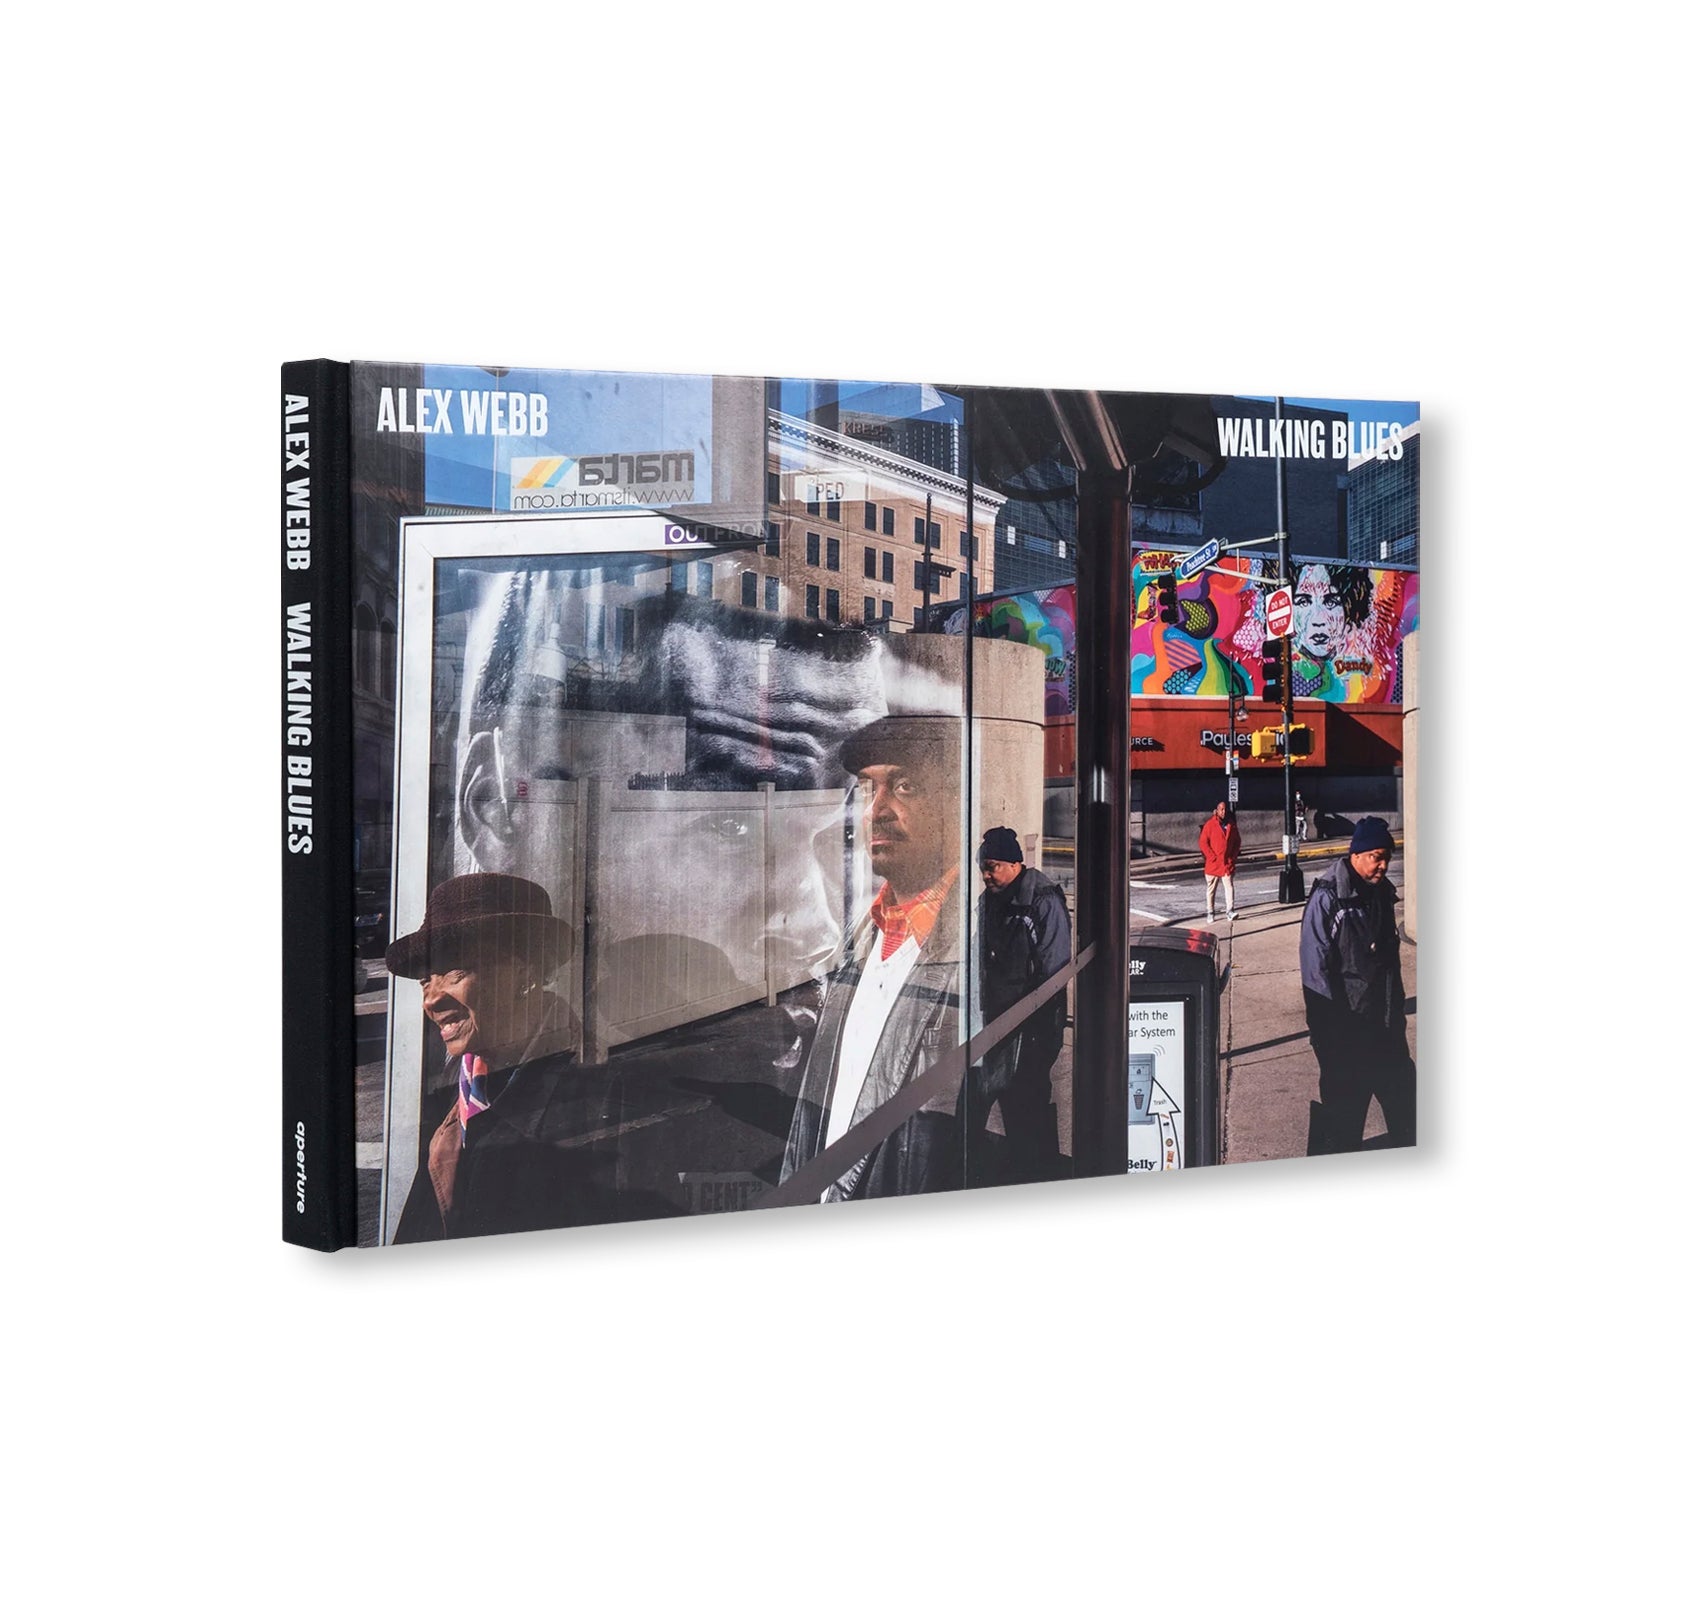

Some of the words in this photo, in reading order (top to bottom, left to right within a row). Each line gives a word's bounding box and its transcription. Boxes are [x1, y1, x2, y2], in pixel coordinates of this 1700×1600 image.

[285, 394, 310, 472] ALEX
[376, 387, 454, 434] ALEX
[459, 390, 548, 437] WEBB
[1217, 417, 1325, 459] WALKING
[1332, 420, 1404, 461] BLUES
[286, 477, 311, 571] WEBB
[1271, 600, 1278, 611] DO
[1279, 596, 1288, 607] NOT
[1272, 617, 1287, 630] ENTER
[286, 602, 312, 746] WALKING
[1202, 730, 1252, 750] Payles
[287, 755, 313, 855] BLUES
[1129, 1010, 1149, 1020] with
[1152, 1010, 1168, 1020] the
[1140, 1027, 1175, 1039] System
[294, 1121, 307, 1214] aperture
